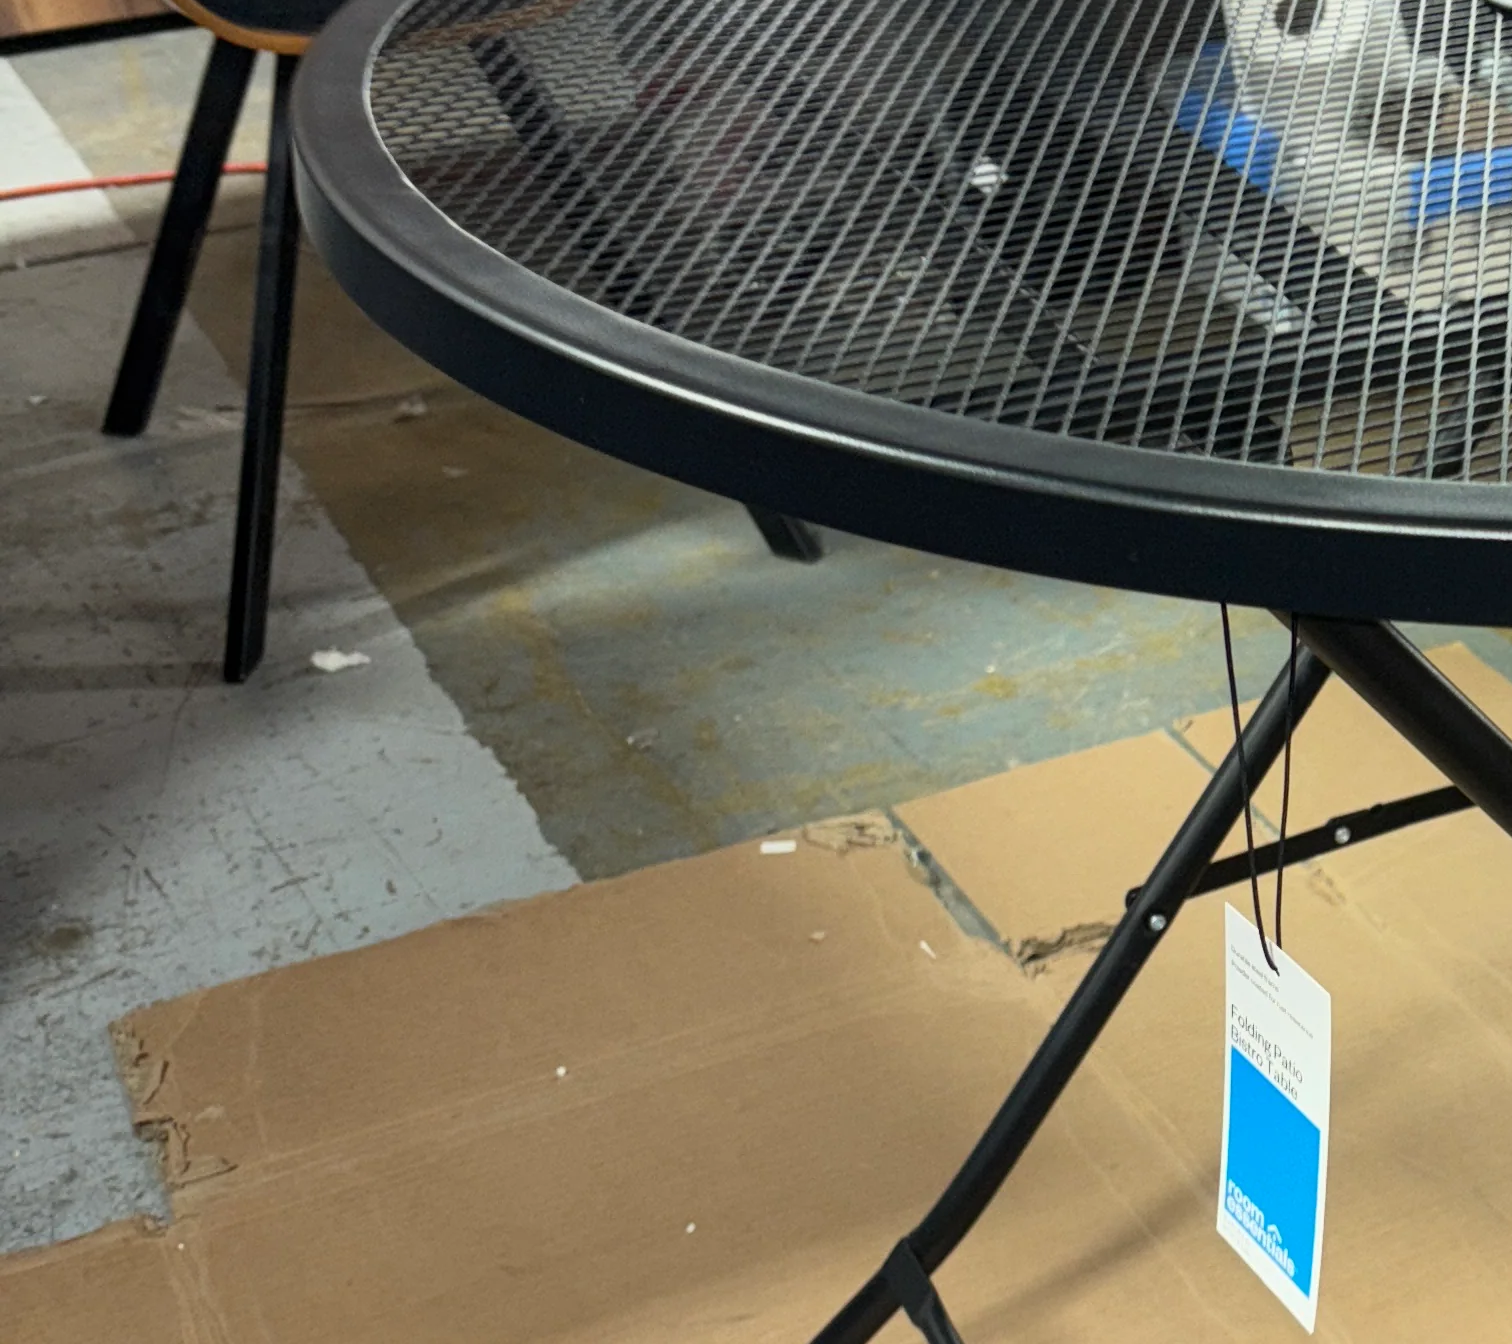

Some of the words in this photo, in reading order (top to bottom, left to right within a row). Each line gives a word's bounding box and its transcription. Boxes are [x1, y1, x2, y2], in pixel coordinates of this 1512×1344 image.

[1231, 1004, 1271, 1060] Folding
[1274, 1044, 1303, 1083] Patio
[1231, 1024, 1263, 1067] Bistro
[1266, 1060, 1298, 1100] Table
[1226, 1195, 1295, 1278] essentials
[1227, 1178, 1265, 1230] room
